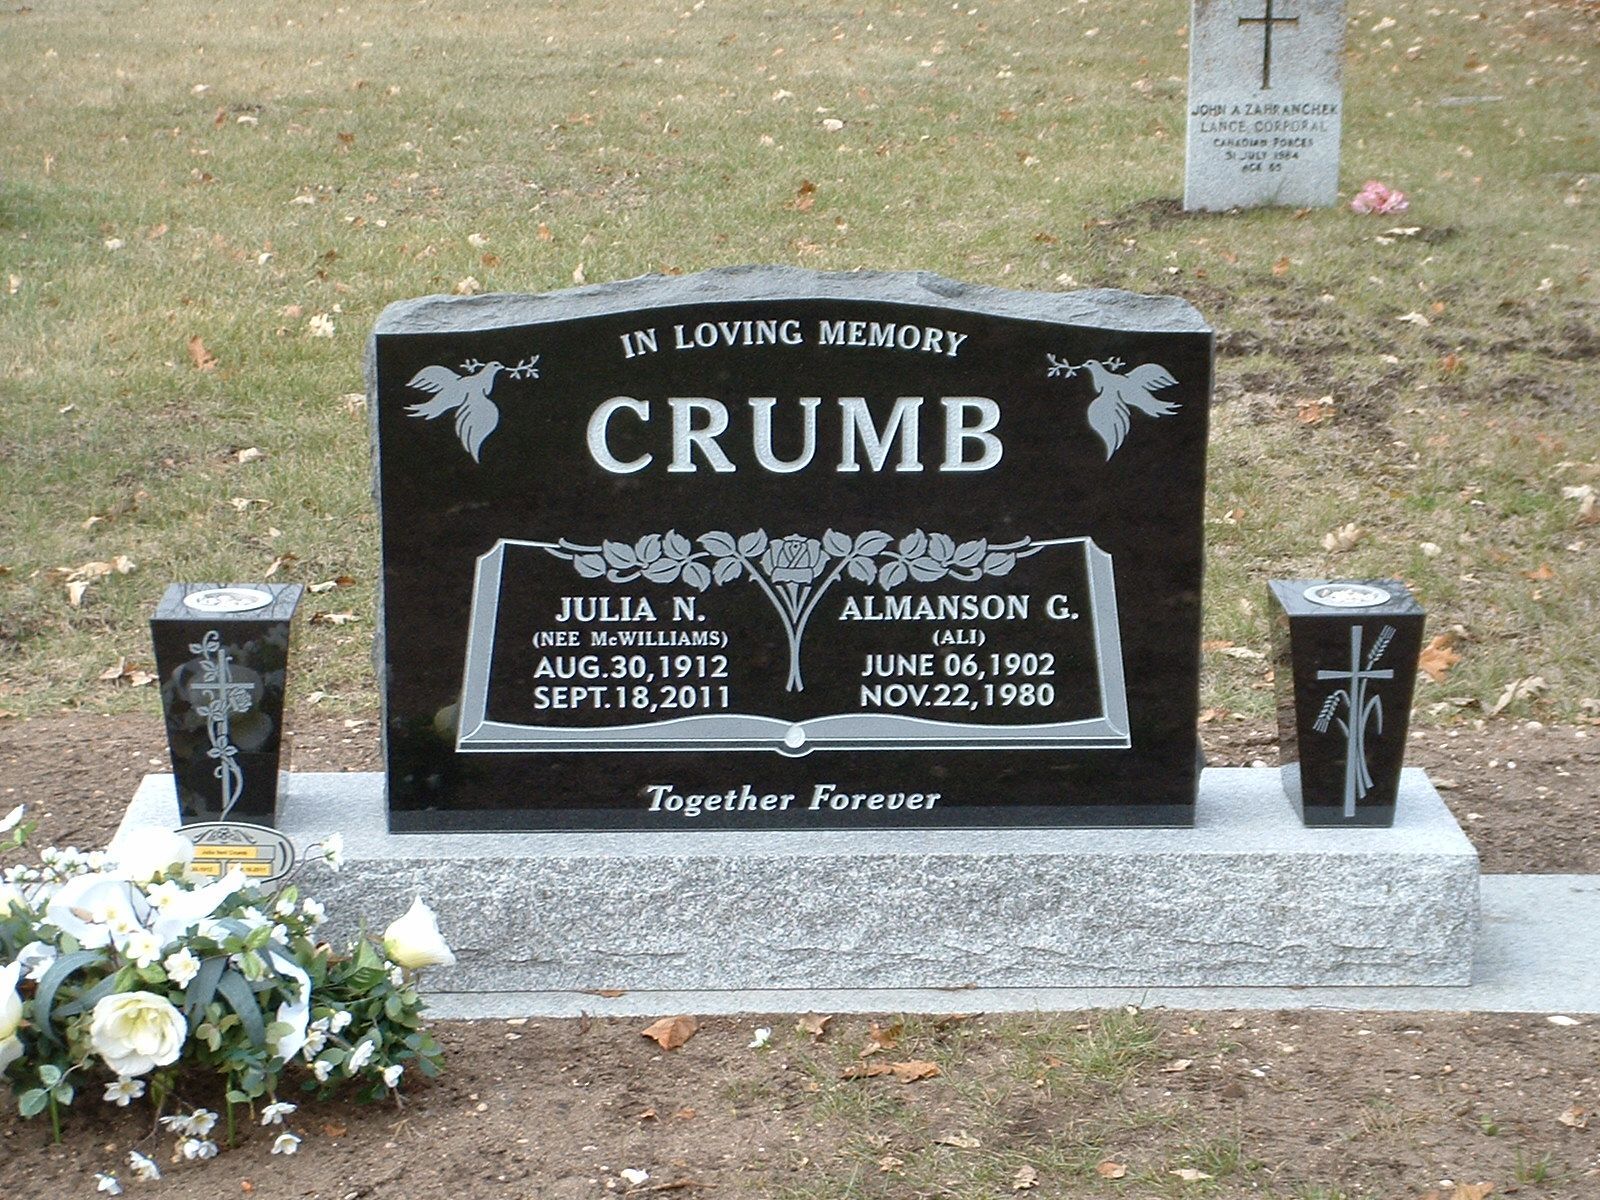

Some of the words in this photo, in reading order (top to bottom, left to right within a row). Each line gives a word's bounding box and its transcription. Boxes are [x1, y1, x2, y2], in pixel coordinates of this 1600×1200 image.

[1191, 104, 1226, 116] JOHN
[1200, 120, 1246, 133] LANCE
[1254, 120, 1328, 133] CORPORAL
[1213, 138, 1267, 148] CANADIAN
[1272, 137, 1314, 148] FORCES
[1239, 151, 1267, 160] JULY
[620, 328, 657, 358] IN
[674, 320, 803, 349] LOVING
[819, 320, 968, 357] MEMORY
[587, 396, 1004, 474] CRUMB
[555, 596, 657, 622] JULIA
[673, 596, 706, 622] N.
[839, 595, 1030, 621] ALMANSON
[1046, 595, 1079, 620] G.
[532, 631, 581, 649] (NEE
[590, 631, 729, 649] McWILLIAMS)
[932, 629, 986, 647] (ALI)
[534, 655, 729, 682] AUG.30,1912
[861, 654, 934, 677] JUNE
[945, 653, 1055, 680] 06,1902
[533, 685, 730, 713] SEPT.18,2011
[860, 683, 1055, 710] NOV.22,1980
[647, 784, 796, 817] Together
[808, 784, 942, 811] Forever
